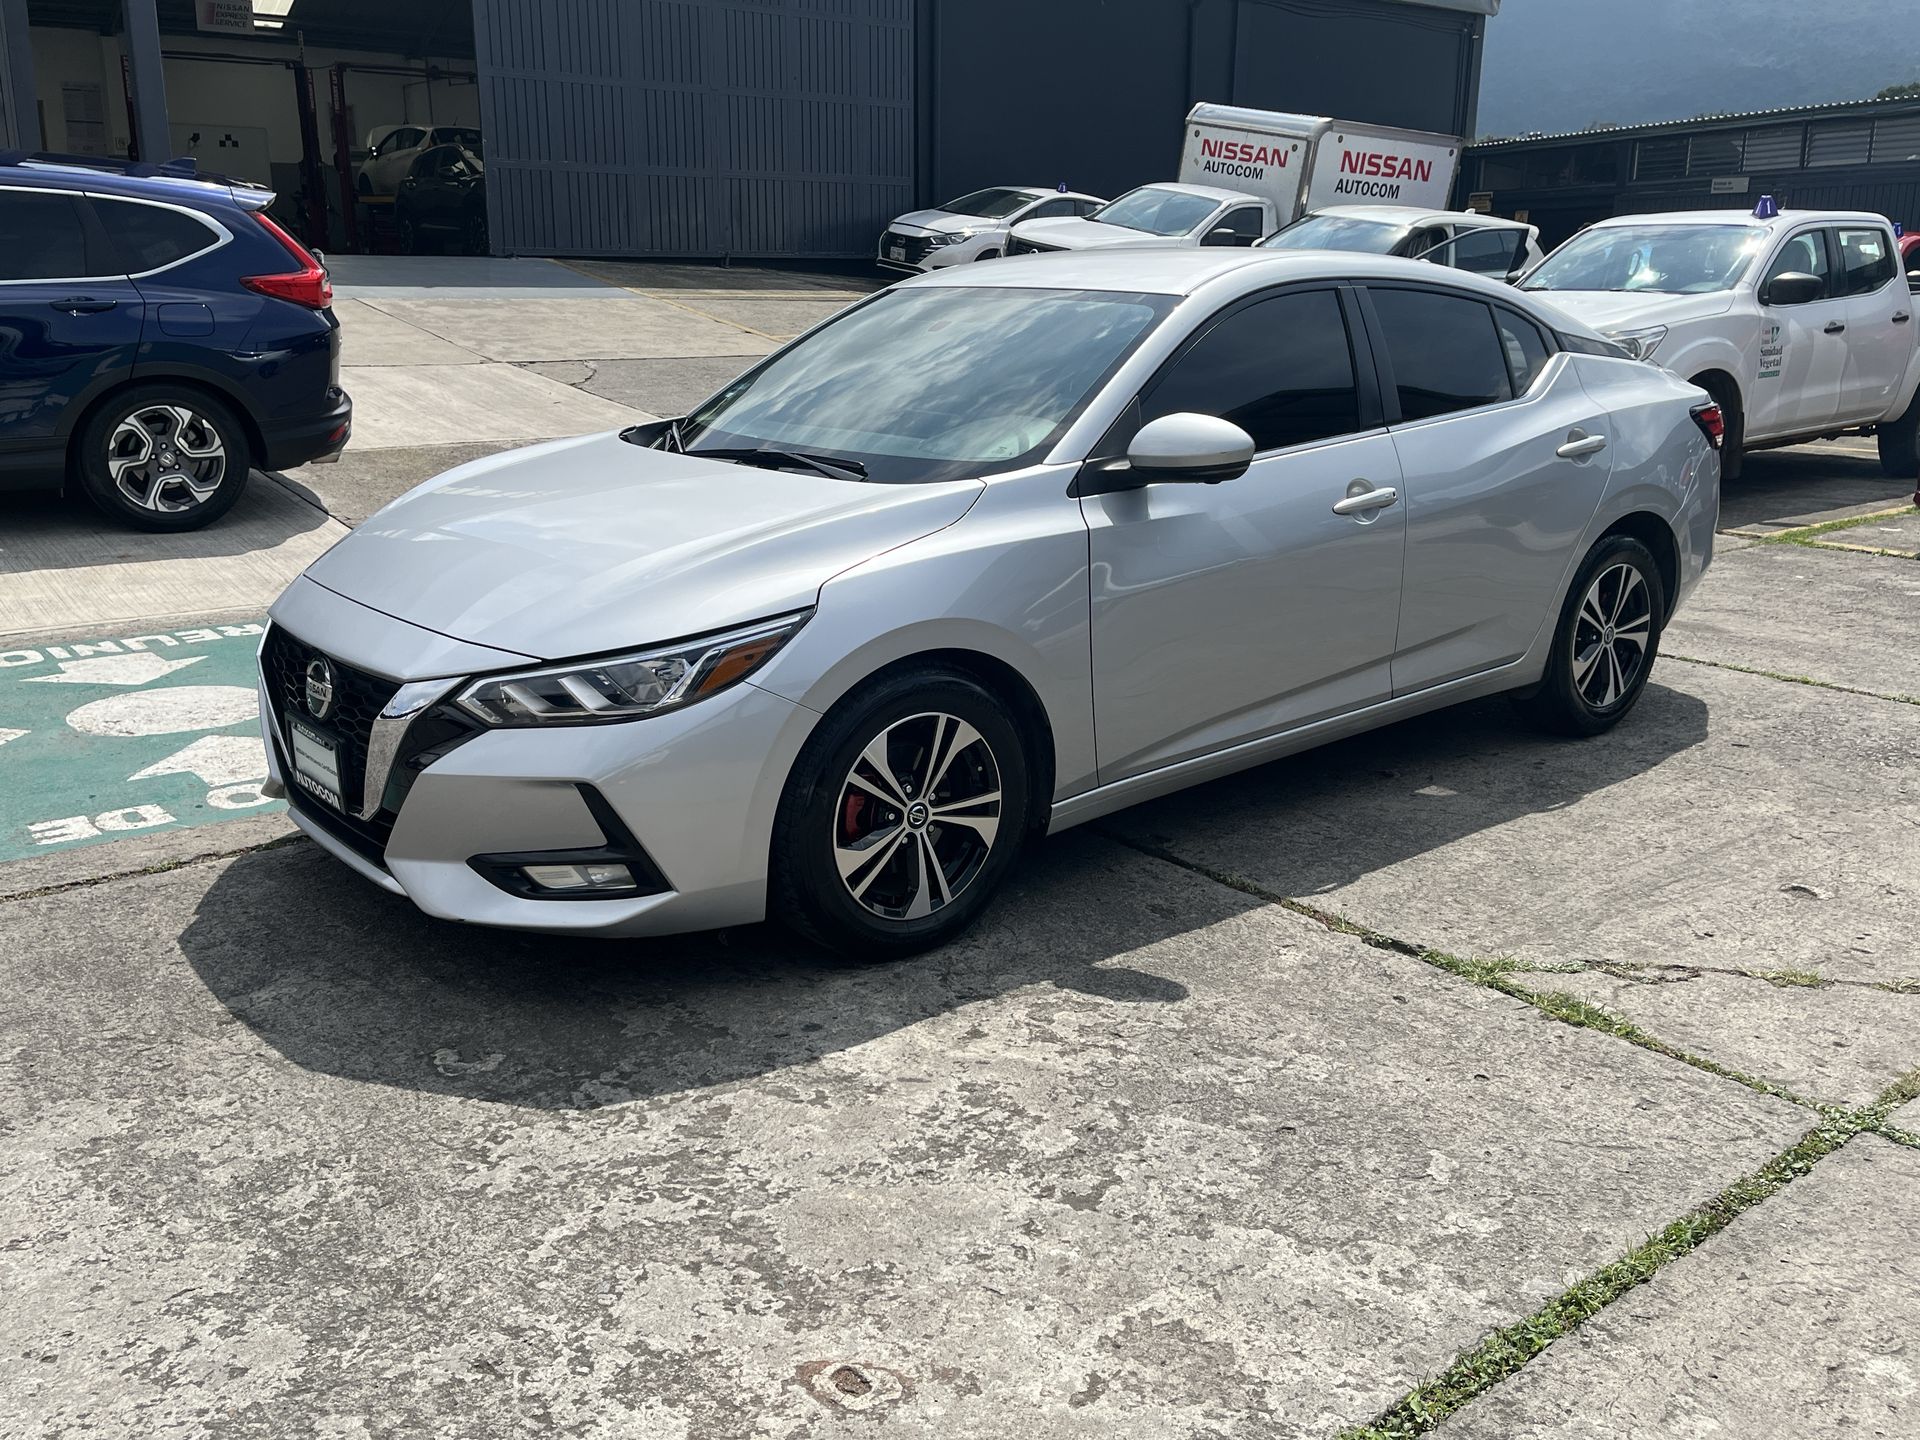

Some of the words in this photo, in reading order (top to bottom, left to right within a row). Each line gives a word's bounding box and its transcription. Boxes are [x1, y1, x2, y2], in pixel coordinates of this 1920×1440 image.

[217, 3, 250, 12] NISSAN
[1201, 138, 1289, 168] NISSAN
[1203, 160, 1264, 180] AUTOCOM
[1340, 150, 1432, 182] NISSAN
[1334, 178, 1400, 199] AUTOCOM
[1759, 356, 1782, 370] Vegetal
[1760, 345, 1783, 357] Sanidad
[0, 624, 264, 668] REUNIO
[296, 769, 341, 810] AUTOCOM
[27, 803, 178, 846] DE
